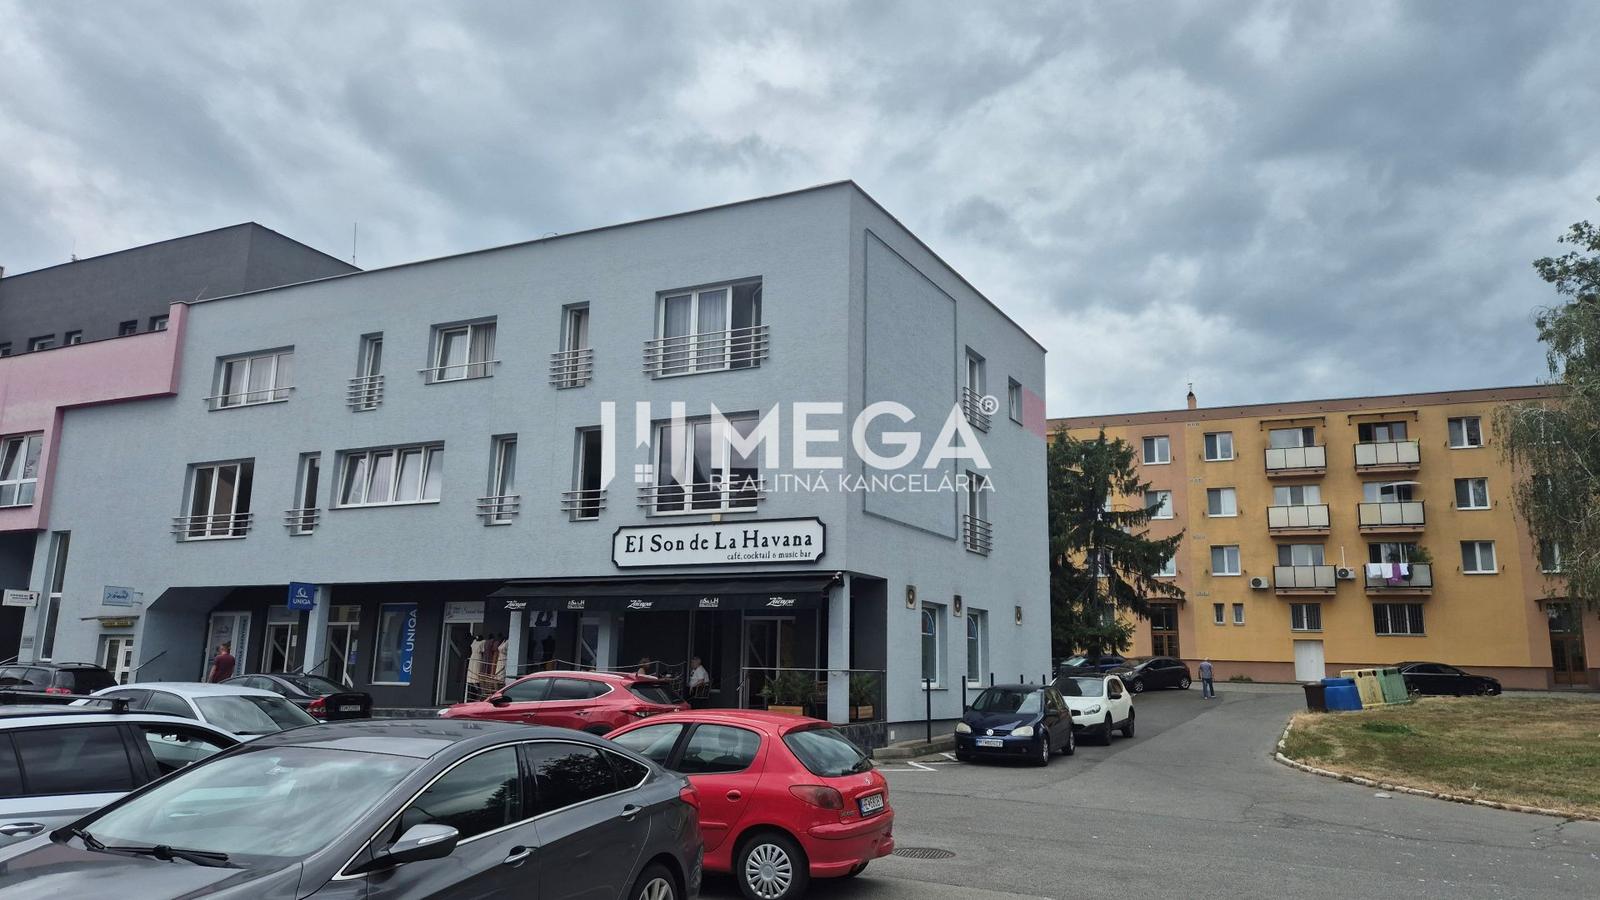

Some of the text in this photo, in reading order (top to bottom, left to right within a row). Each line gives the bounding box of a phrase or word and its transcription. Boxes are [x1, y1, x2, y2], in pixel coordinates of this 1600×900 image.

[625, 529, 813, 553] El Son de La Havana
[743, 551, 771, 560] cocktail
[778, 551, 799, 559] music
[799, 550, 811, 558] bar
[405, 609, 417, 652] UNIQA
